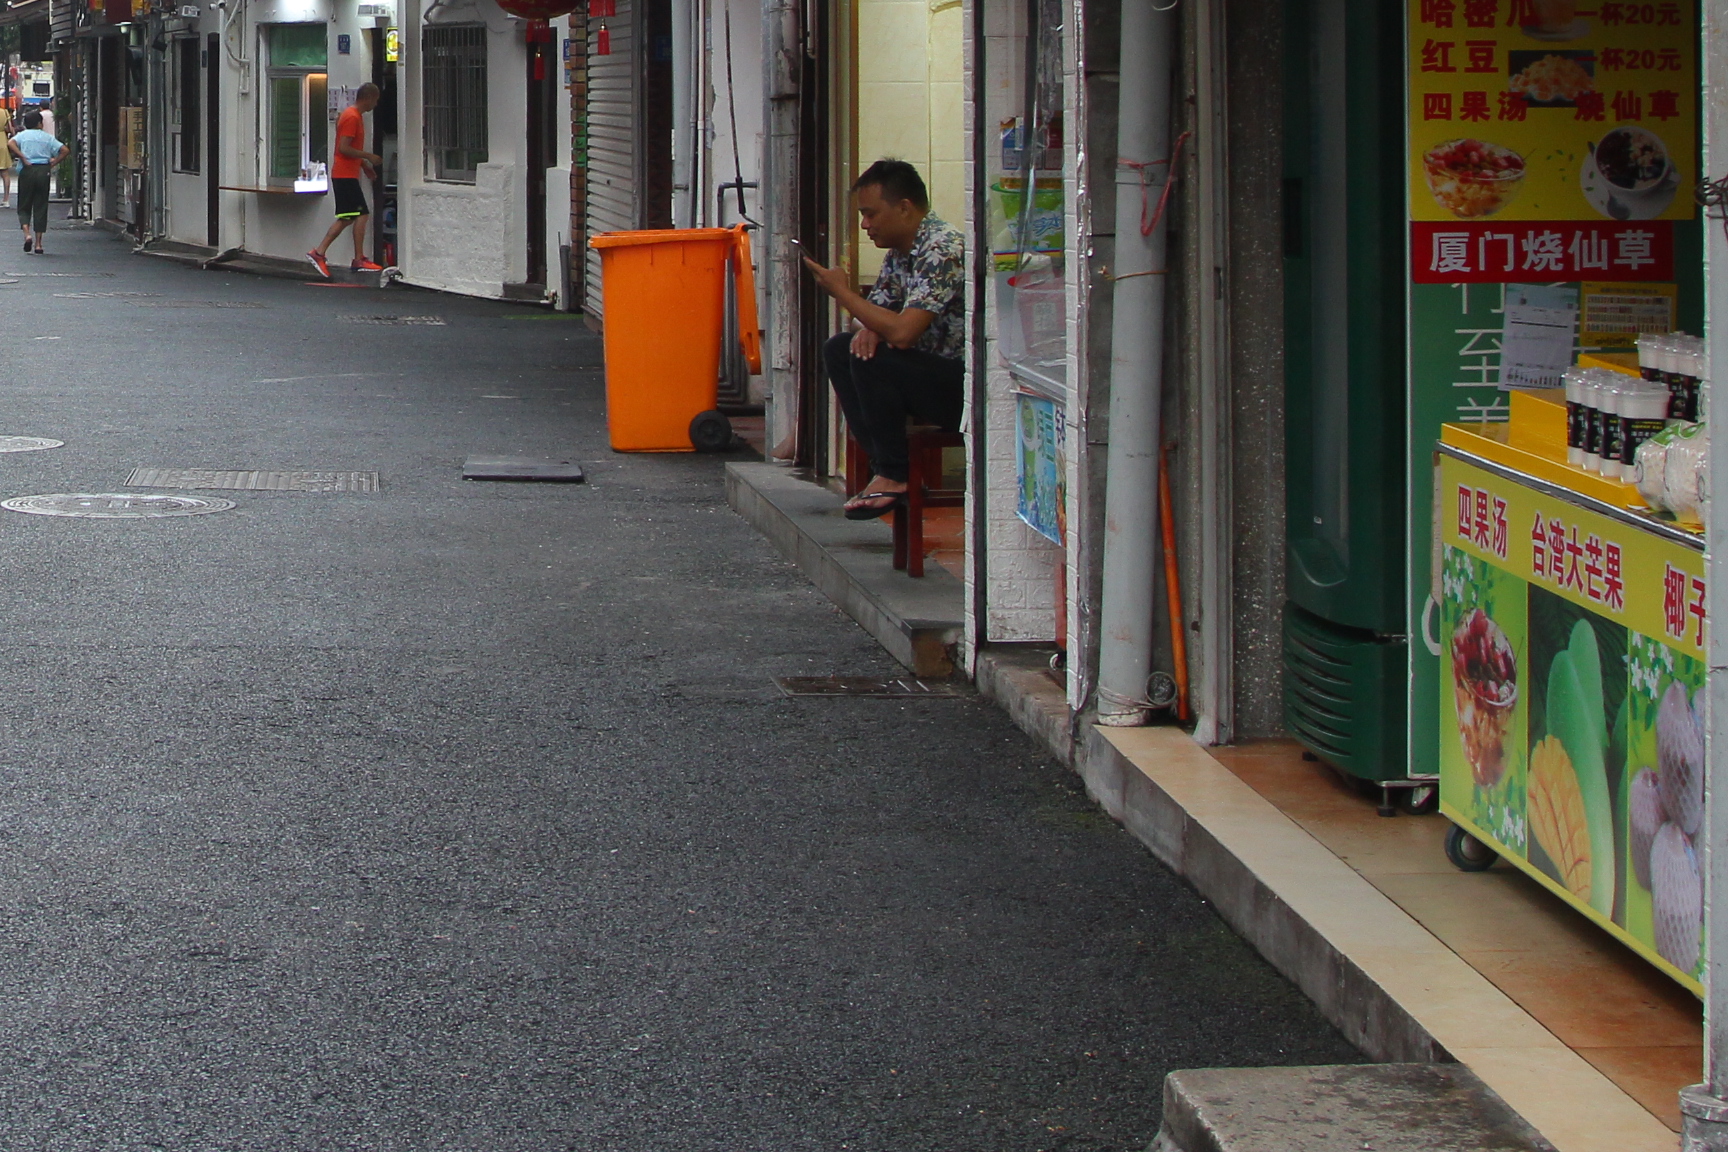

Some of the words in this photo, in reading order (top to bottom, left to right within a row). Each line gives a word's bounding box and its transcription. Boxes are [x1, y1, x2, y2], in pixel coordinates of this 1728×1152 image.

[1574, 2, 1682, 27] 一杯20元
[1421, 38, 1499, 73] 红豆
[1576, 47, 1682, 72] 一杯20元
[1423, 90, 1529, 122] 四果汤
[1573, 90, 1680, 122] 烧仙草
[1429, 228, 1656, 275] 厦门烧仙草
[1457, 484, 1508, 560] 四果汤
[1531, 512, 1624, 611] 台湾大芒果
